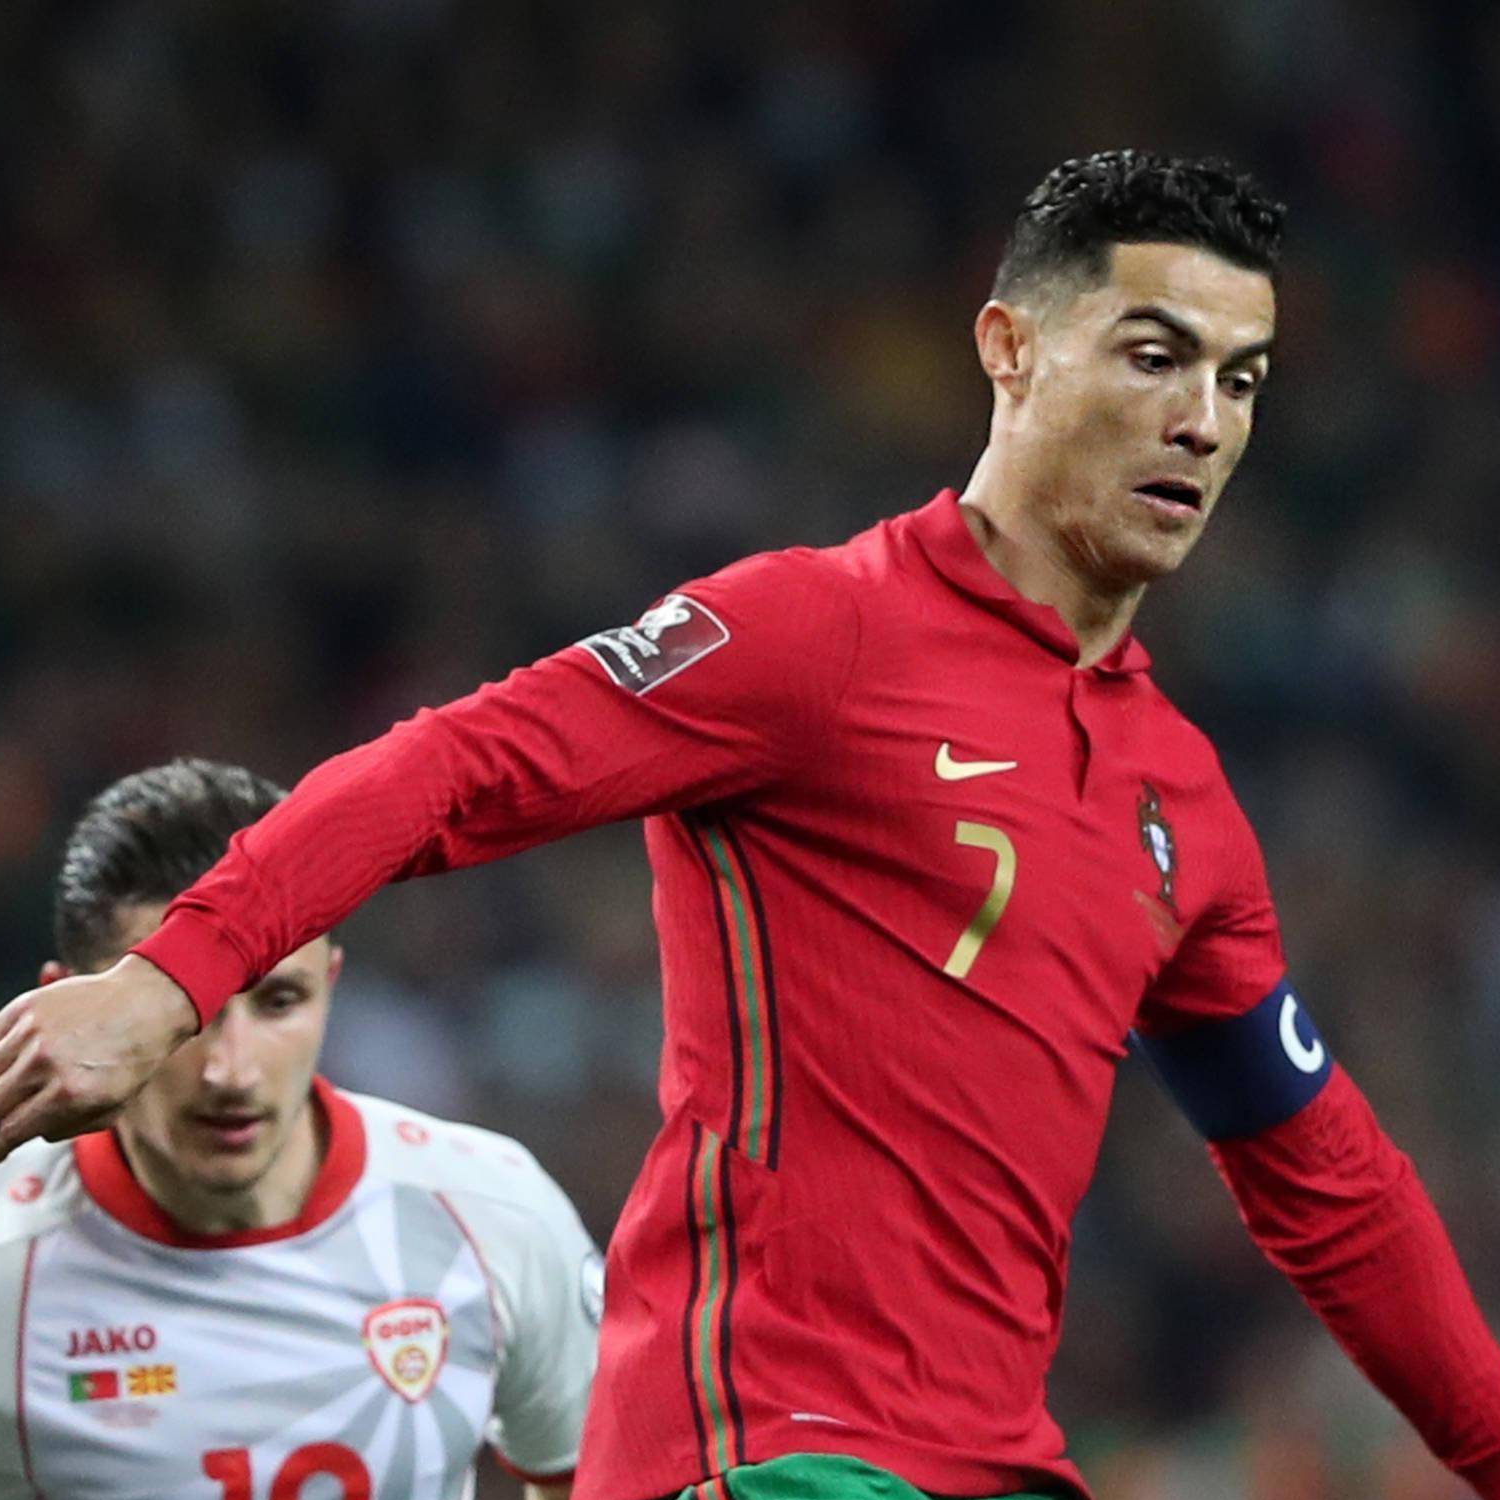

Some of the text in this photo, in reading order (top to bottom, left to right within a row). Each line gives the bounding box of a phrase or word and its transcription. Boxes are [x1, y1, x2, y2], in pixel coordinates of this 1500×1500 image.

[943, 820, 1017, 979] 7
[1279, 993, 1325, 1075] C
[66, 1324, 156, 1358] JAKO
